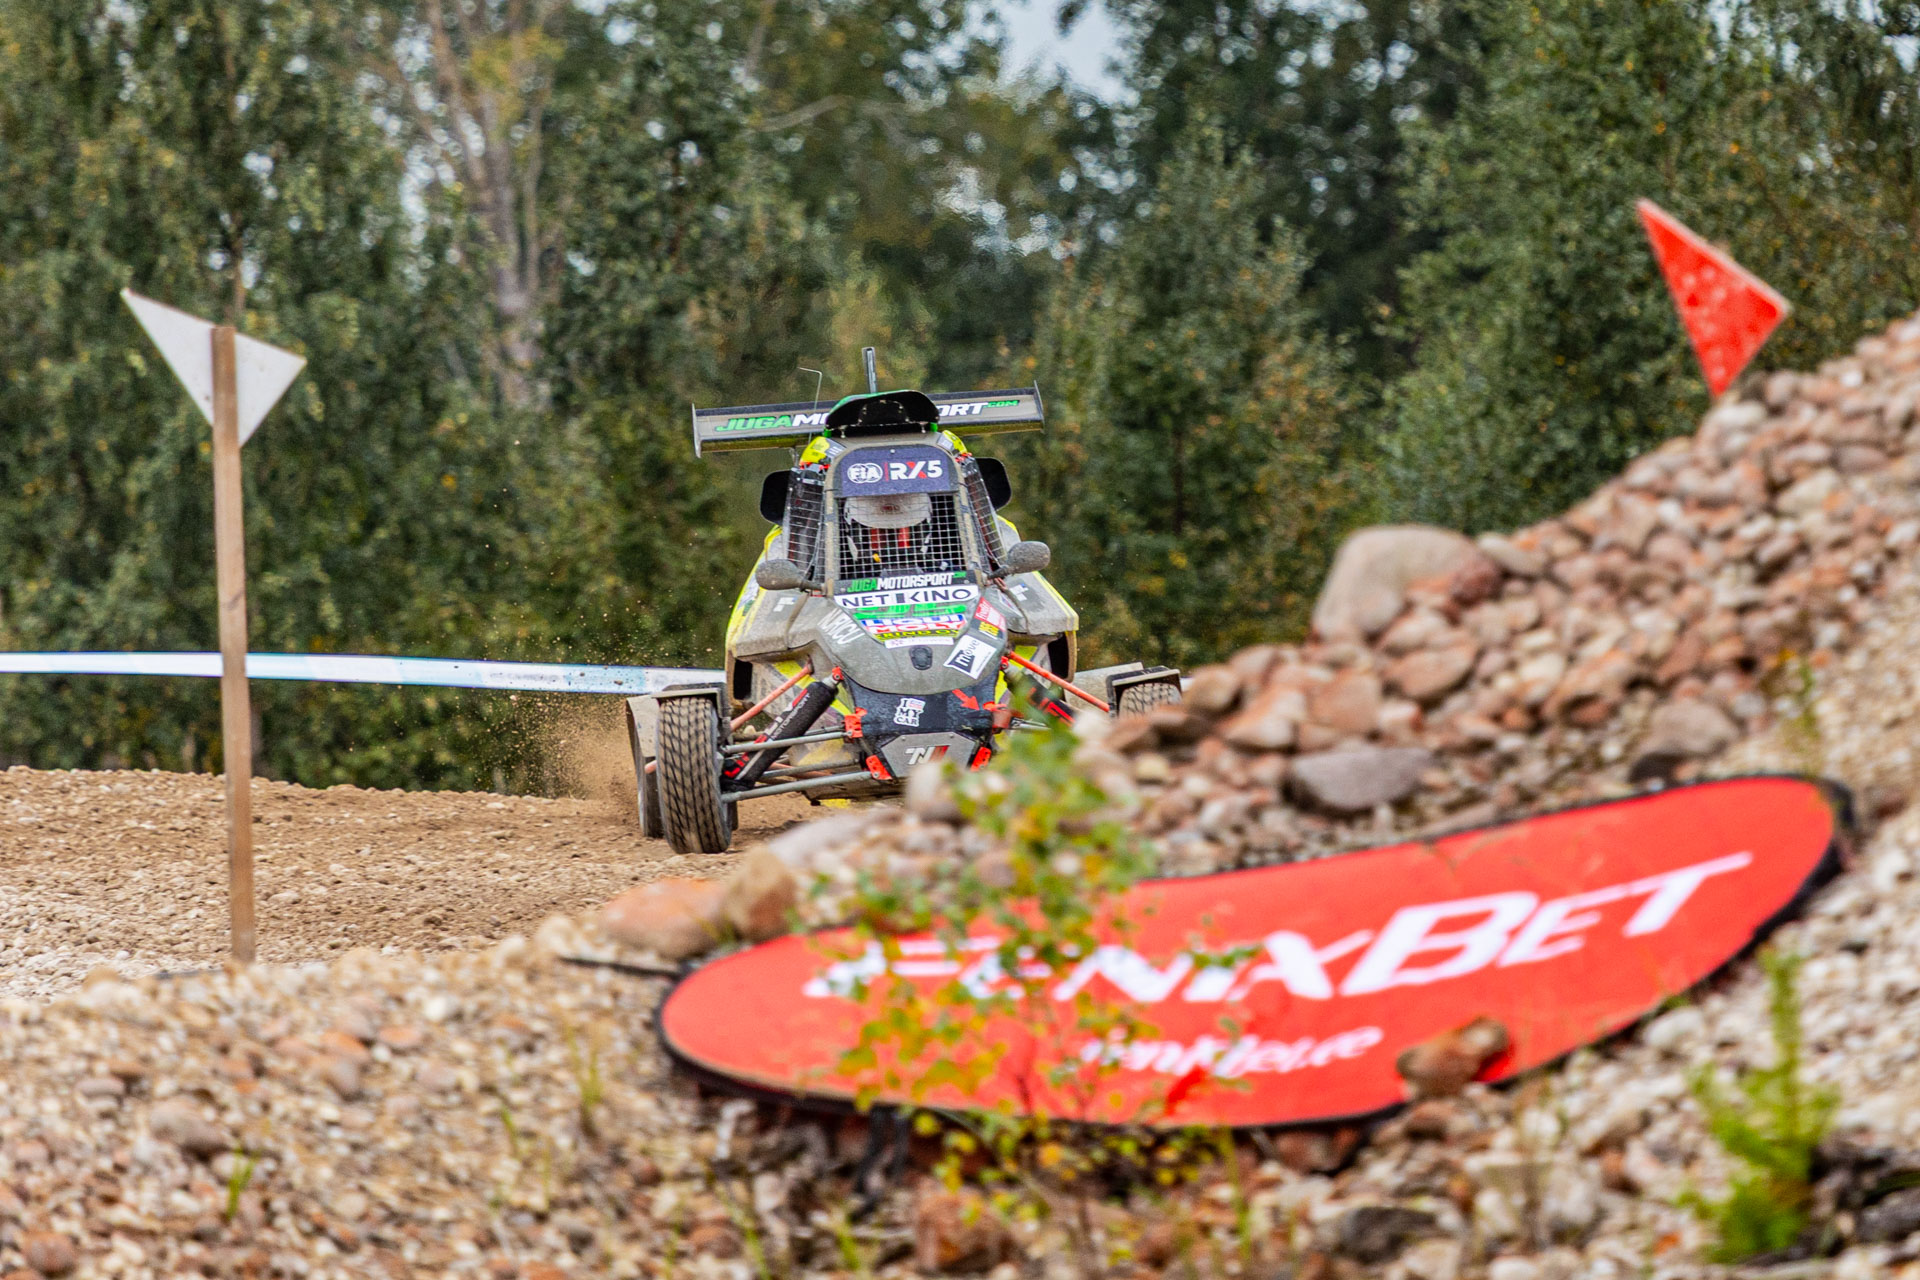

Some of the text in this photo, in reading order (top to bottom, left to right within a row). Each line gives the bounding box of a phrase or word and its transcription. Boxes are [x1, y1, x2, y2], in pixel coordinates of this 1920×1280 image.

[849, 460, 943, 481] FIA RX5
[861, 614, 965, 627] LIQUI
[867, 621, 965, 634] MOLY
[955, 640, 980, 667] move
[899, 707, 920, 718] MY
[896, 716, 918, 726] CAR
